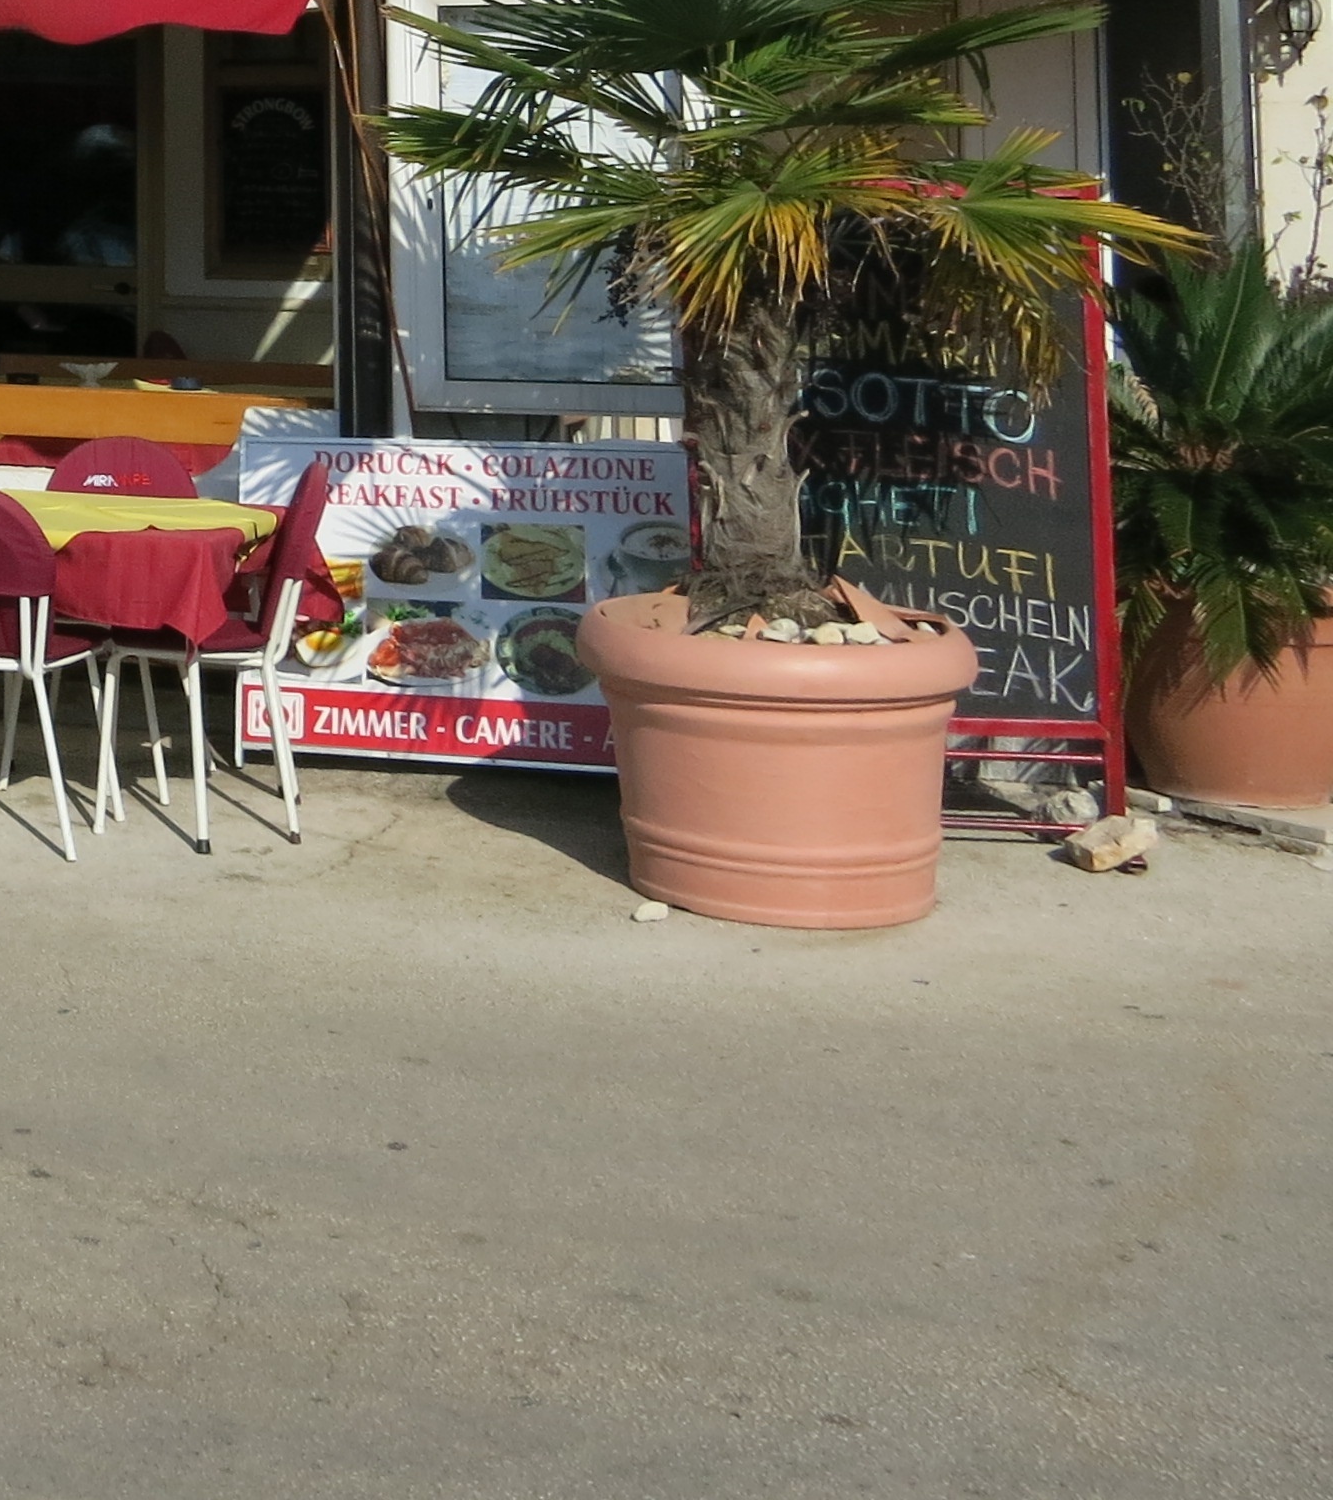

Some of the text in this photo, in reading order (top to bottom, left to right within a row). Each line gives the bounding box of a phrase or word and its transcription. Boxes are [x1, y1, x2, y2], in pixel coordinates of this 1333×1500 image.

[231, 97, 317, 132] STRONGBOW
[314, 446, 656, 482] DORUČAK COLAZIONE
[324, 482, 676, 517] REAKFAST FRÜHSTÜCK
[312, 704, 428, 741] ZIMMER
[455, 715, 573, 751] CAMERE
